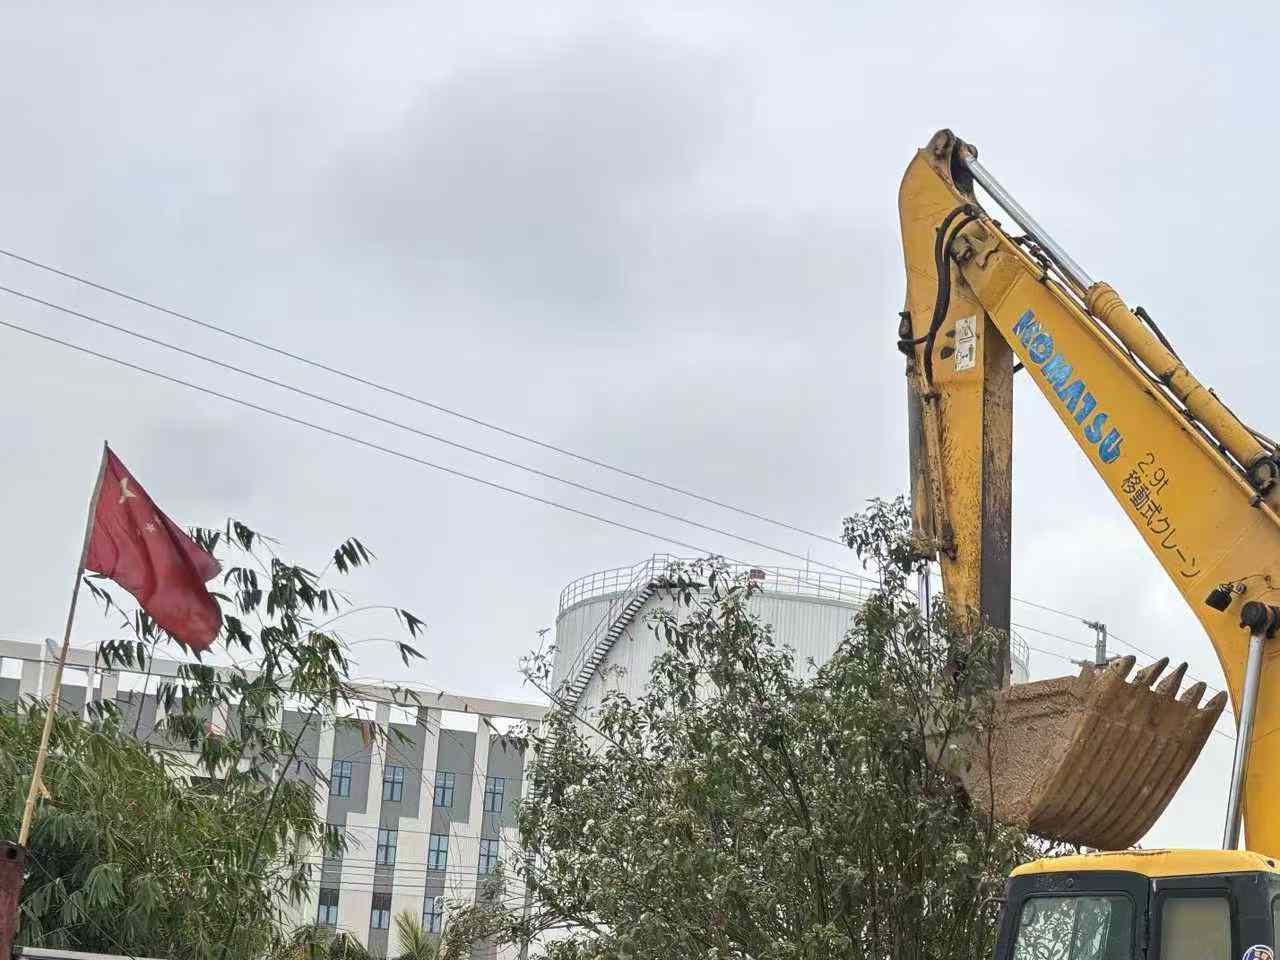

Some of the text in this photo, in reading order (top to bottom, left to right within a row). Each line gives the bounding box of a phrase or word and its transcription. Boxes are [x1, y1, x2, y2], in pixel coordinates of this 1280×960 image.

[1012, 308, 1124, 464] KOMATSU
[1120, 469, 1201, 577] 移動式クレーン
[1137, 452, 1169, 496] 2.9t
